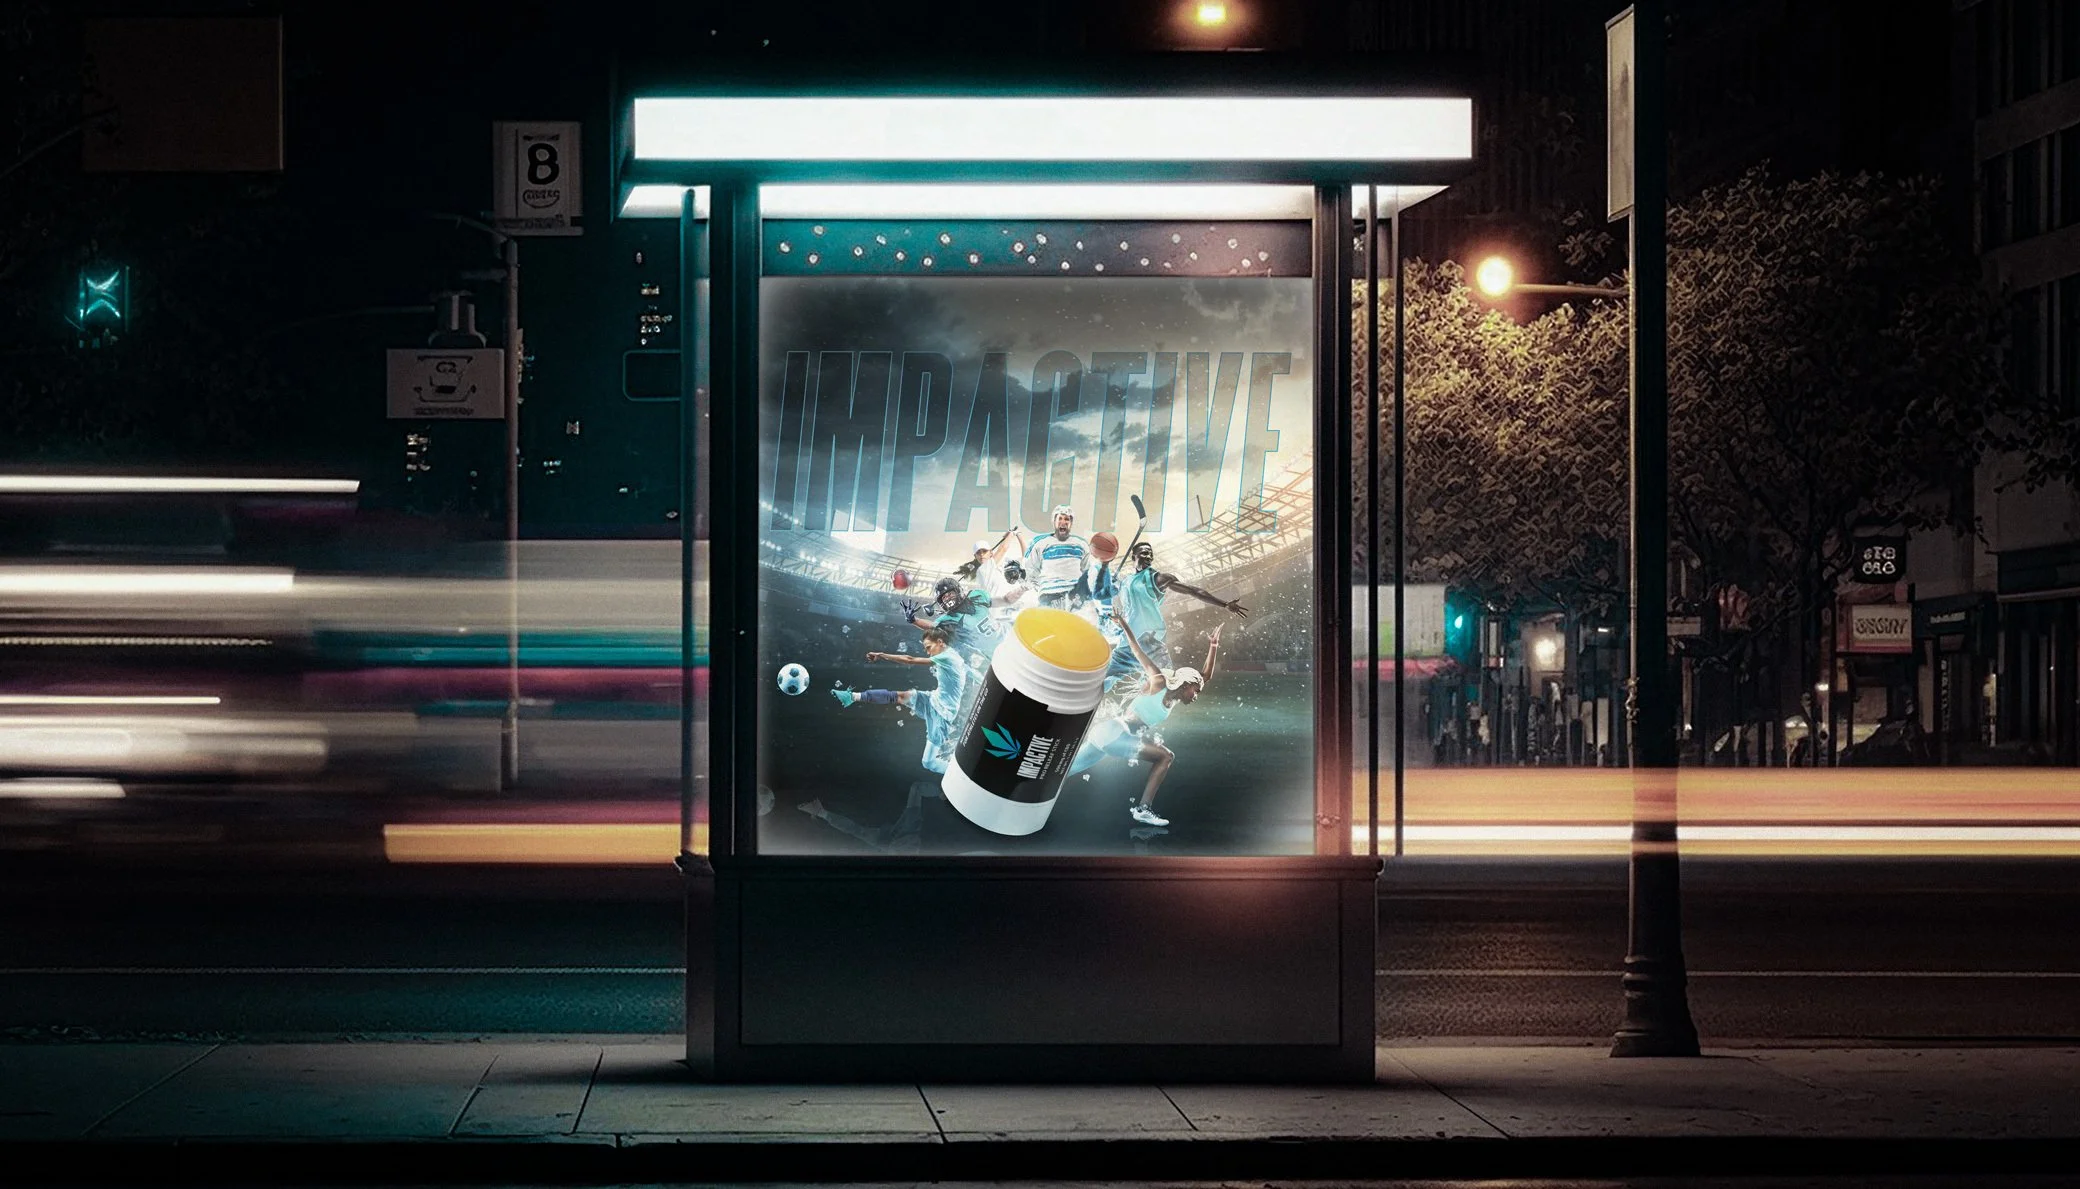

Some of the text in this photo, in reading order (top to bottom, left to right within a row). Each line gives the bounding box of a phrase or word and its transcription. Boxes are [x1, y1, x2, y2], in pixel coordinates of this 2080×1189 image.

[527, 142, 560, 185] 8
[769, 350, 1293, 533] IMPACTIVE
[1016, 734, 1054, 779] IMPACTIVE
